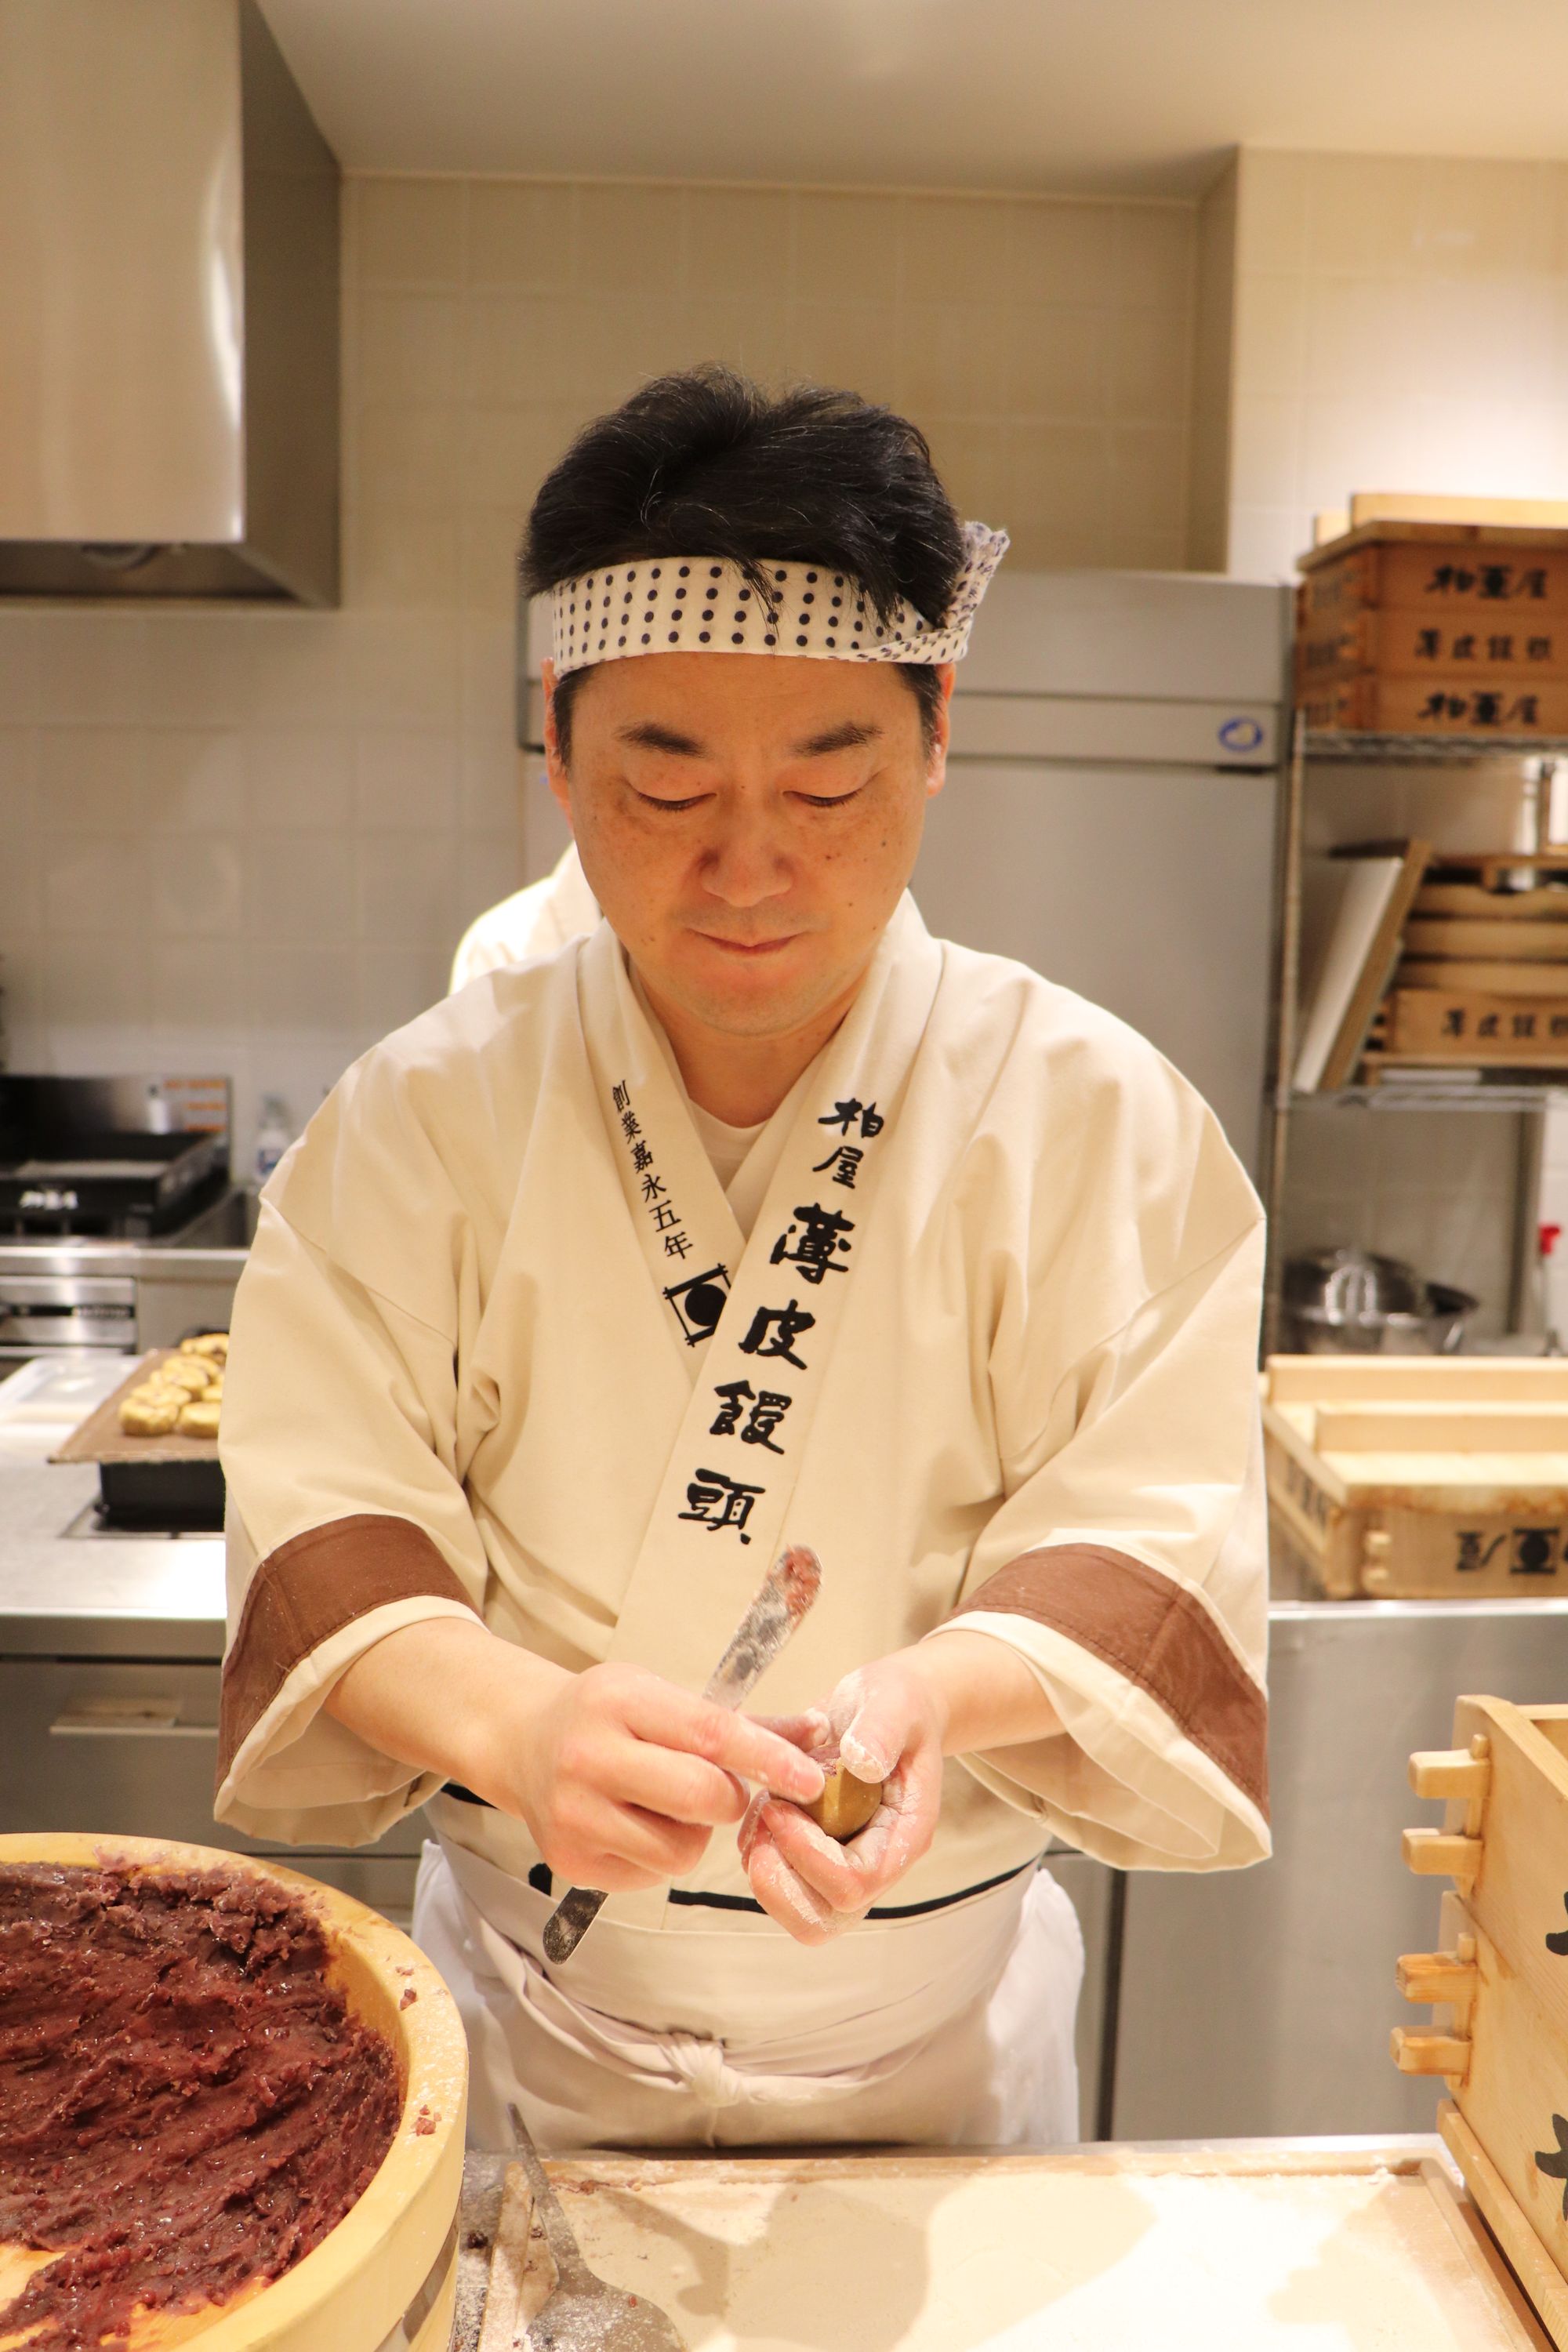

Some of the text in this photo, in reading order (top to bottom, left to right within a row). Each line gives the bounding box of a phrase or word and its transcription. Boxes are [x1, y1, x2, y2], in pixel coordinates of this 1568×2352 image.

[612, 1079, 694, 1260] 創業嘉永五年
